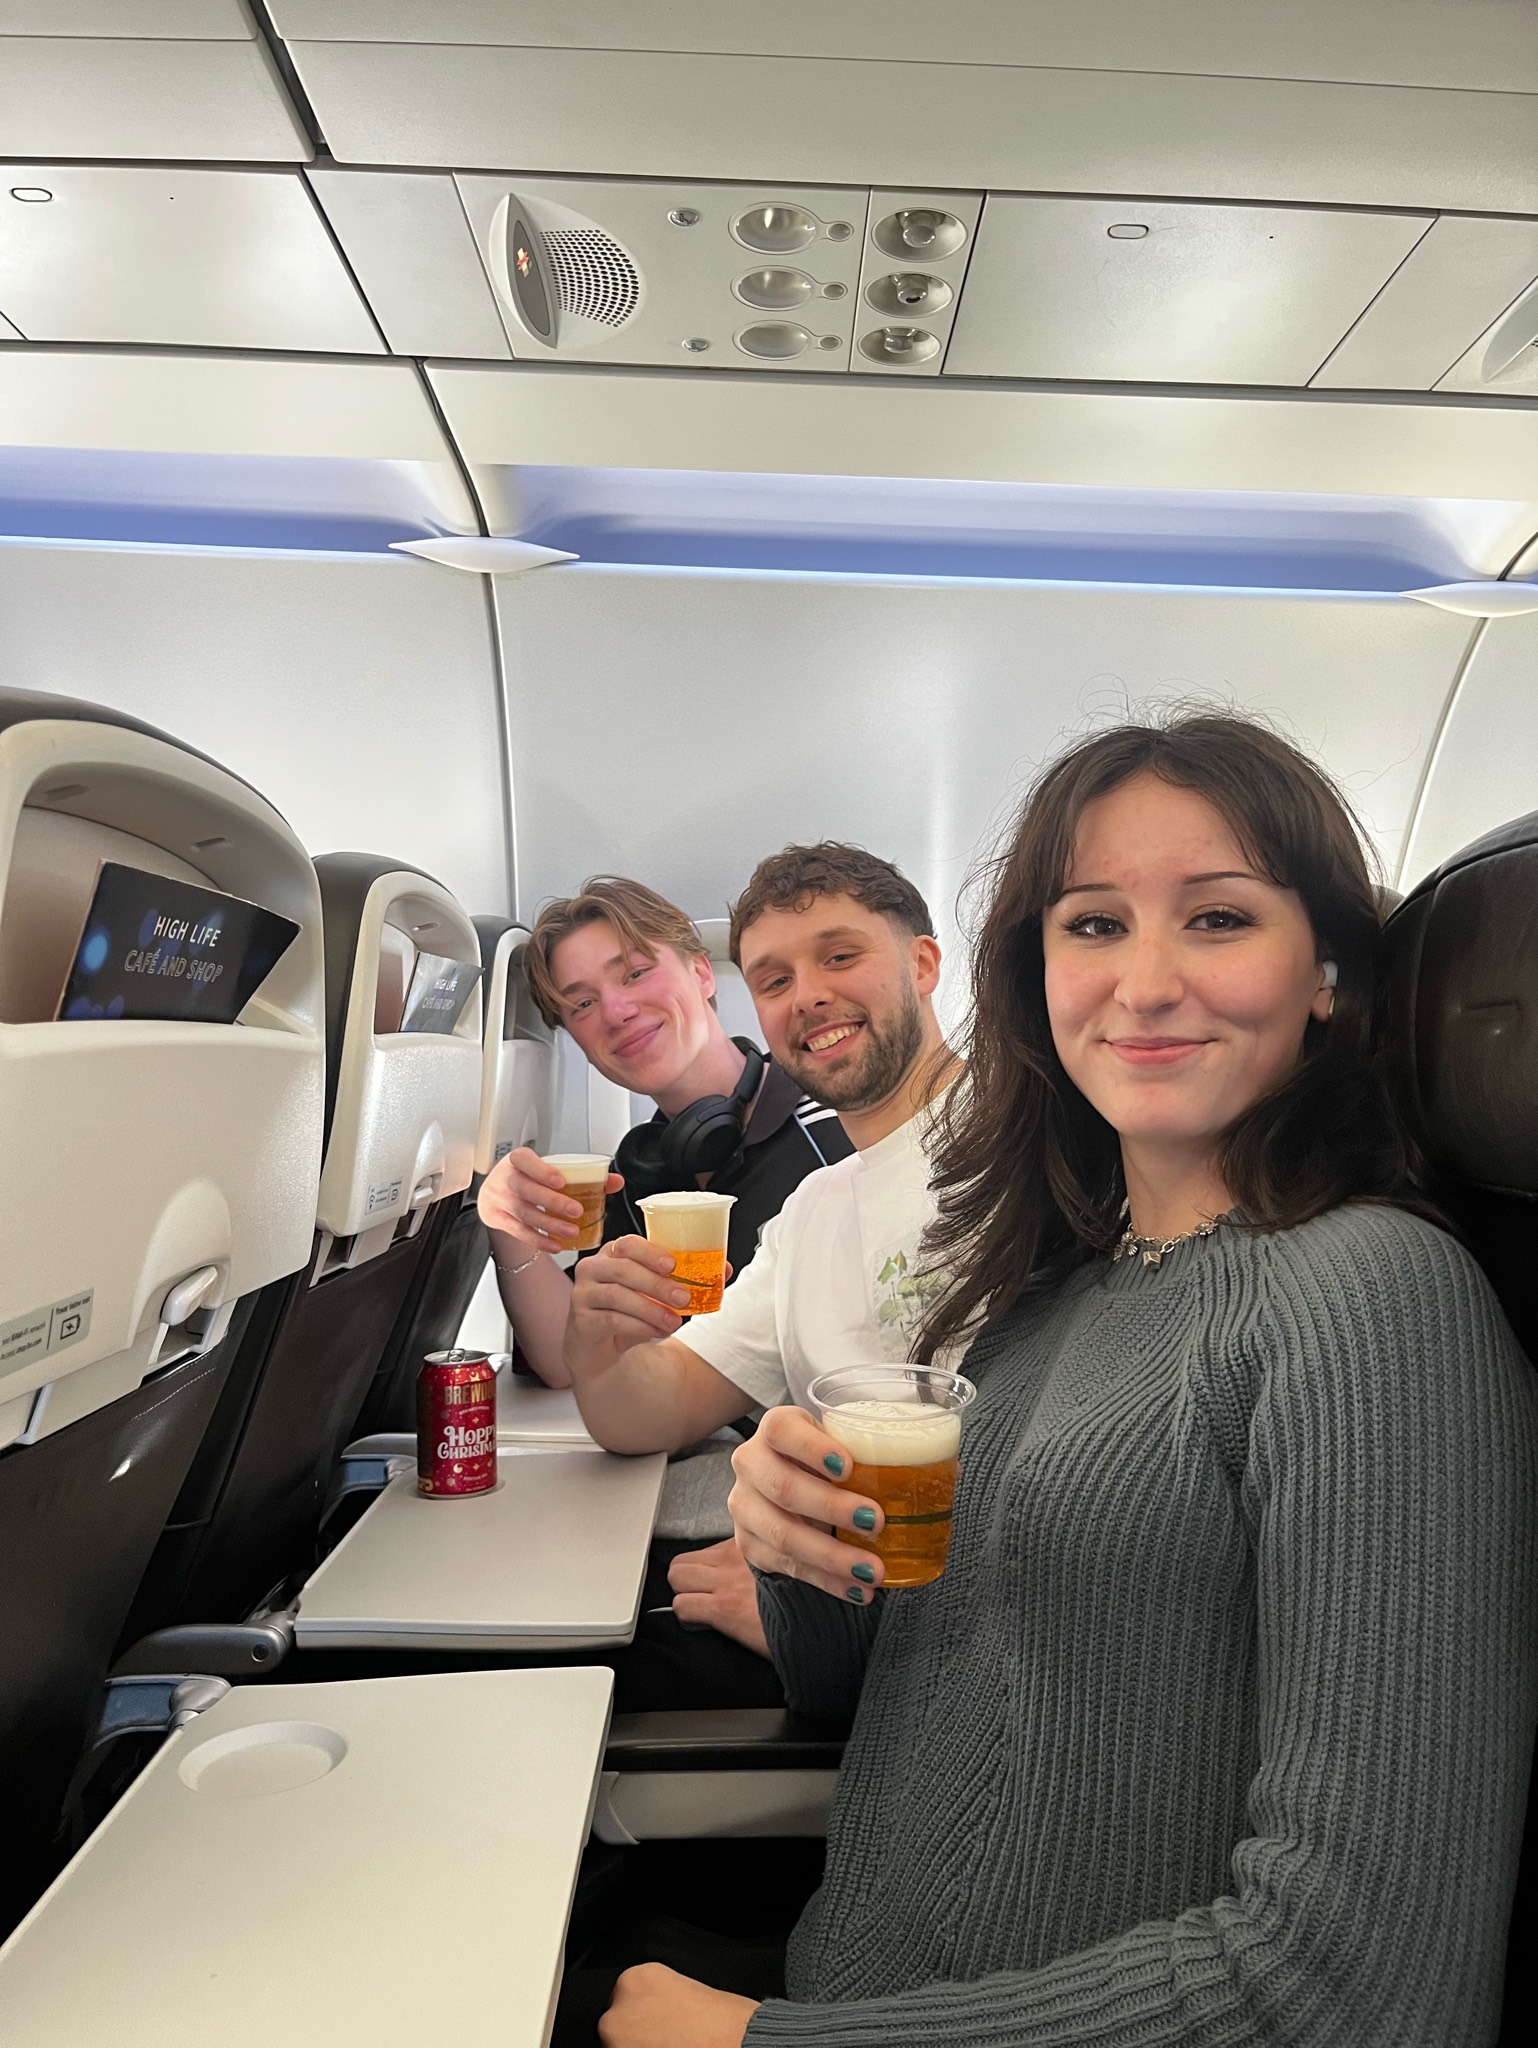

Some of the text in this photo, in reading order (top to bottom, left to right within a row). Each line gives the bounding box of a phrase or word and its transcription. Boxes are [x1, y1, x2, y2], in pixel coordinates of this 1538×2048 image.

[154, 916, 221, 947] HIGH LIFE
[124, 948, 223, 983] CAFÉ AND SHOP
[433, 978, 457, 992] HIGH LIFE
